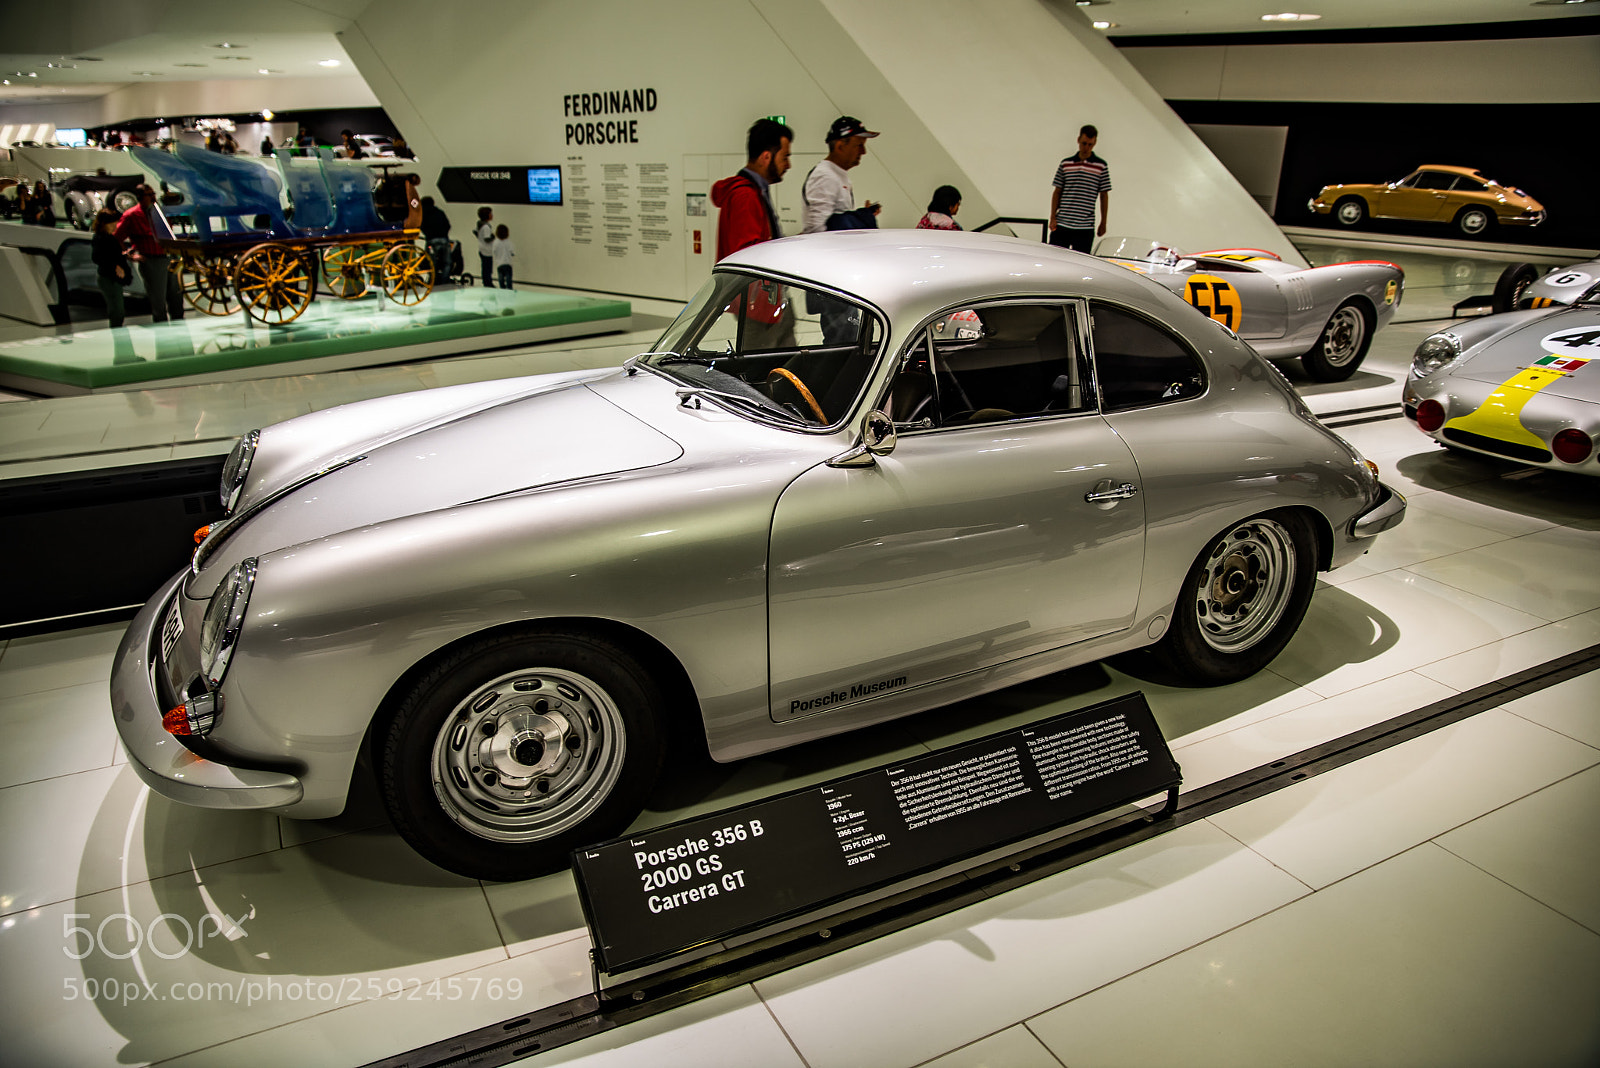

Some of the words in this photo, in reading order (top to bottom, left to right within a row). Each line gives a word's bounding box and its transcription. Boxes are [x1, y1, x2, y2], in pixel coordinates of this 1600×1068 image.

[564, 88, 657, 117] FERDINAND
[565, 120, 639, 146] PORSCHE
[1555, 273, 1582, 284] 6
[1188, 282, 1233, 330] 55
[1547, 330, 1600, 348] 4
[790, 691, 847, 714] Porsche
[850, 676, 907, 699] Museum
[827, 801, 842, 811] 1960
[848, 810, 865, 819] Boxer
[852, 826, 865, 834] ccm
[634, 838, 709, 870] Porsche
[711, 824, 747, 847] 356
[749, 819, 765, 837] B
[842, 843, 853, 852] 175
[852, 841, 861, 849] PS
[861, 837, 874, 847] (129
[873, 833, 886, 842] kW)
[847, 857, 859, 866] 220
[859, 852, 876, 863] km/h
[641, 863, 692, 892] 2000
[695, 854, 723, 875] GS
[648, 882, 719, 914] Carrera
[721, 869, 746, 892] GT
